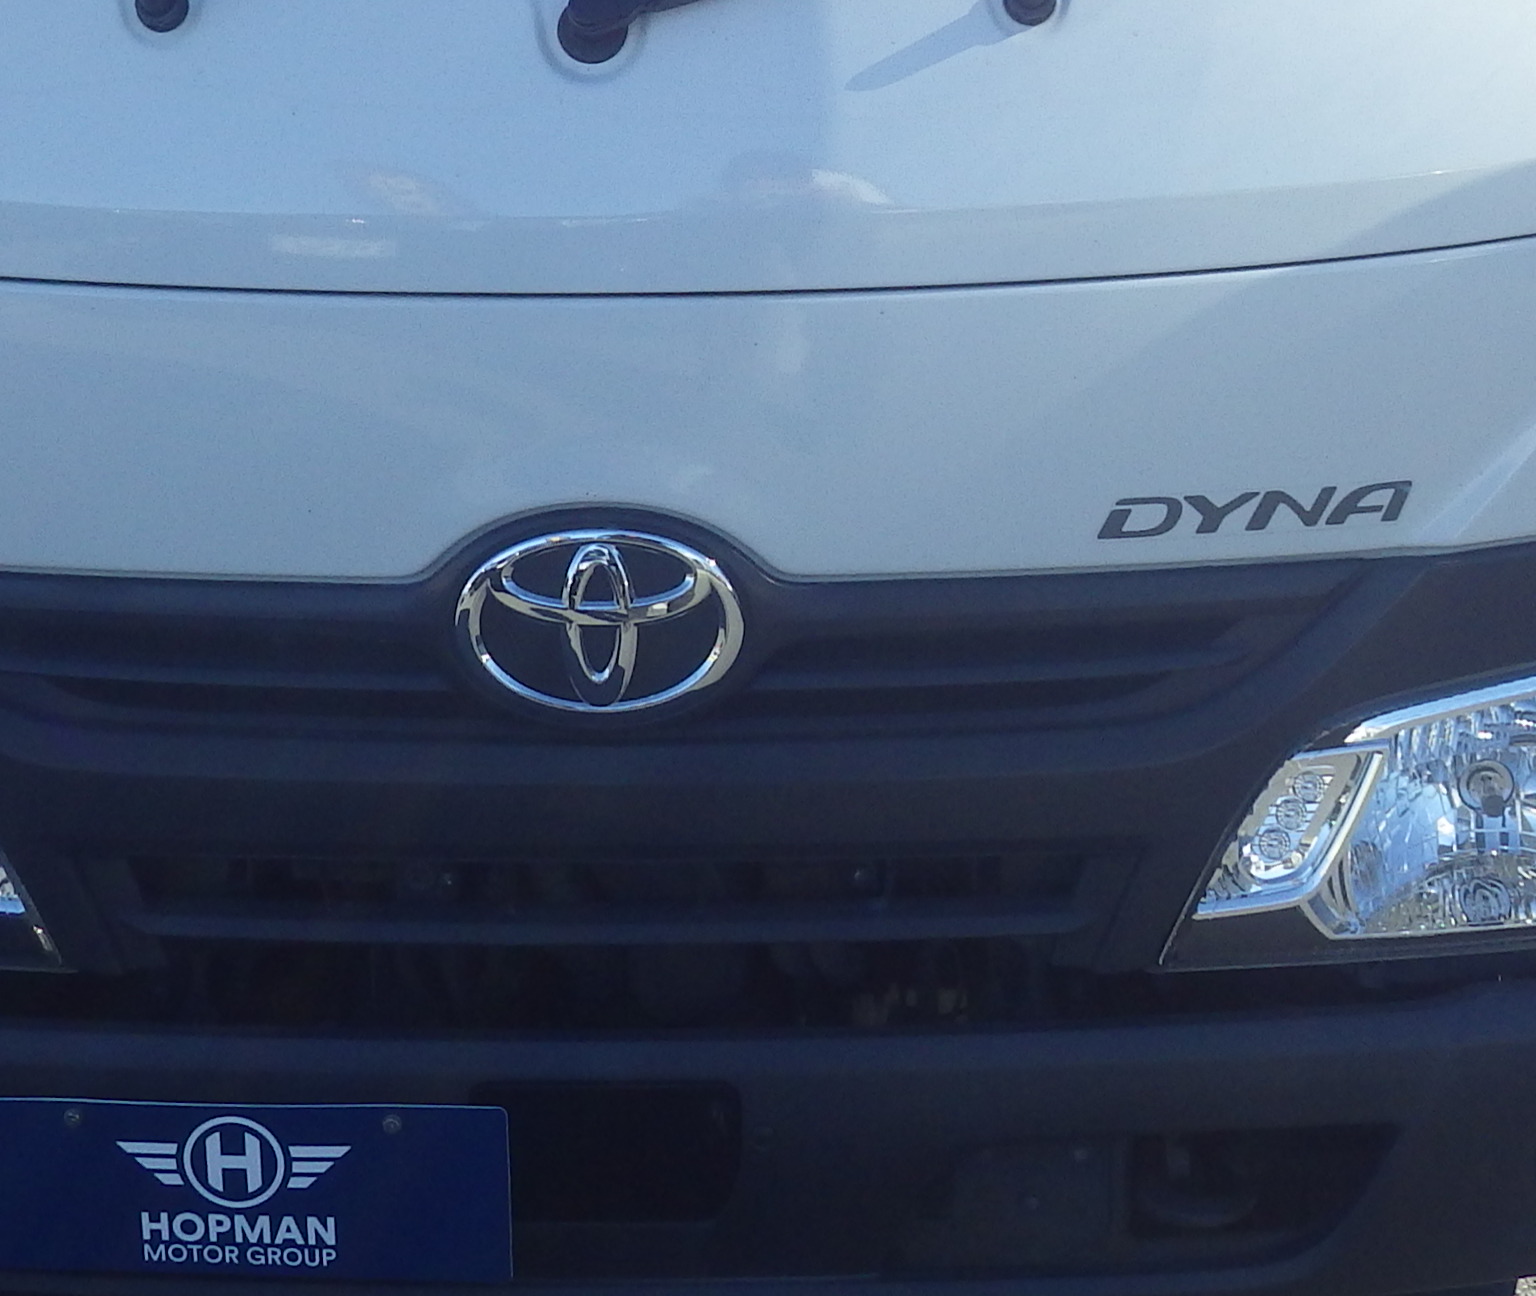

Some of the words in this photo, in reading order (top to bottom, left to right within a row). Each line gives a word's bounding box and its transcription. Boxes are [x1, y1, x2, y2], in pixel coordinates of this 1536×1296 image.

[1096, 479, 1413, 539] DYNA
[140, 1211, 337, 1245] HOPMAN
[143, 1244, 239, 1265] MOTOR
[246, 1246, 337, 1268] GROUP
